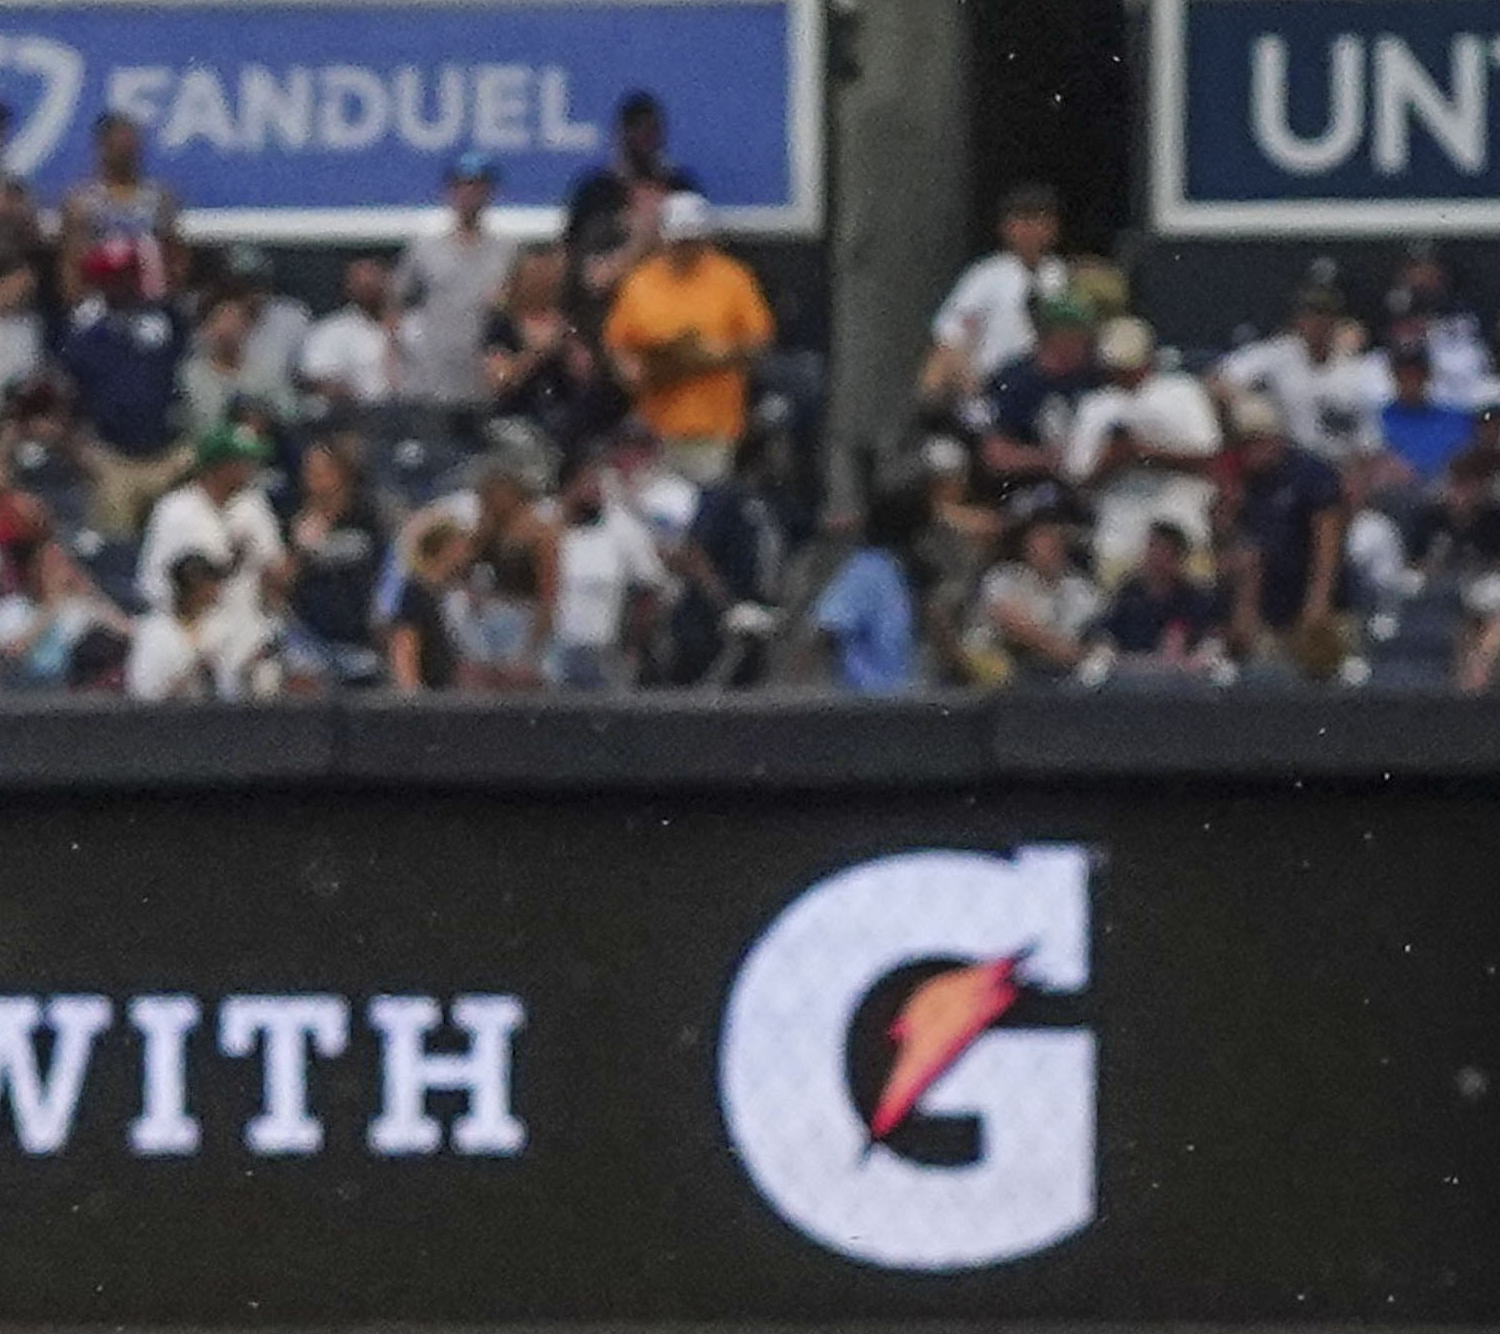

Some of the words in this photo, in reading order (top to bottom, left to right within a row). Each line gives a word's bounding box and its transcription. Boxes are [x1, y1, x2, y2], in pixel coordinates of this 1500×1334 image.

[106, 64, 599, 152] FANDUEL
[1251, 33, 1500, 174] UN
[716, 840, 1098, 1273] G
